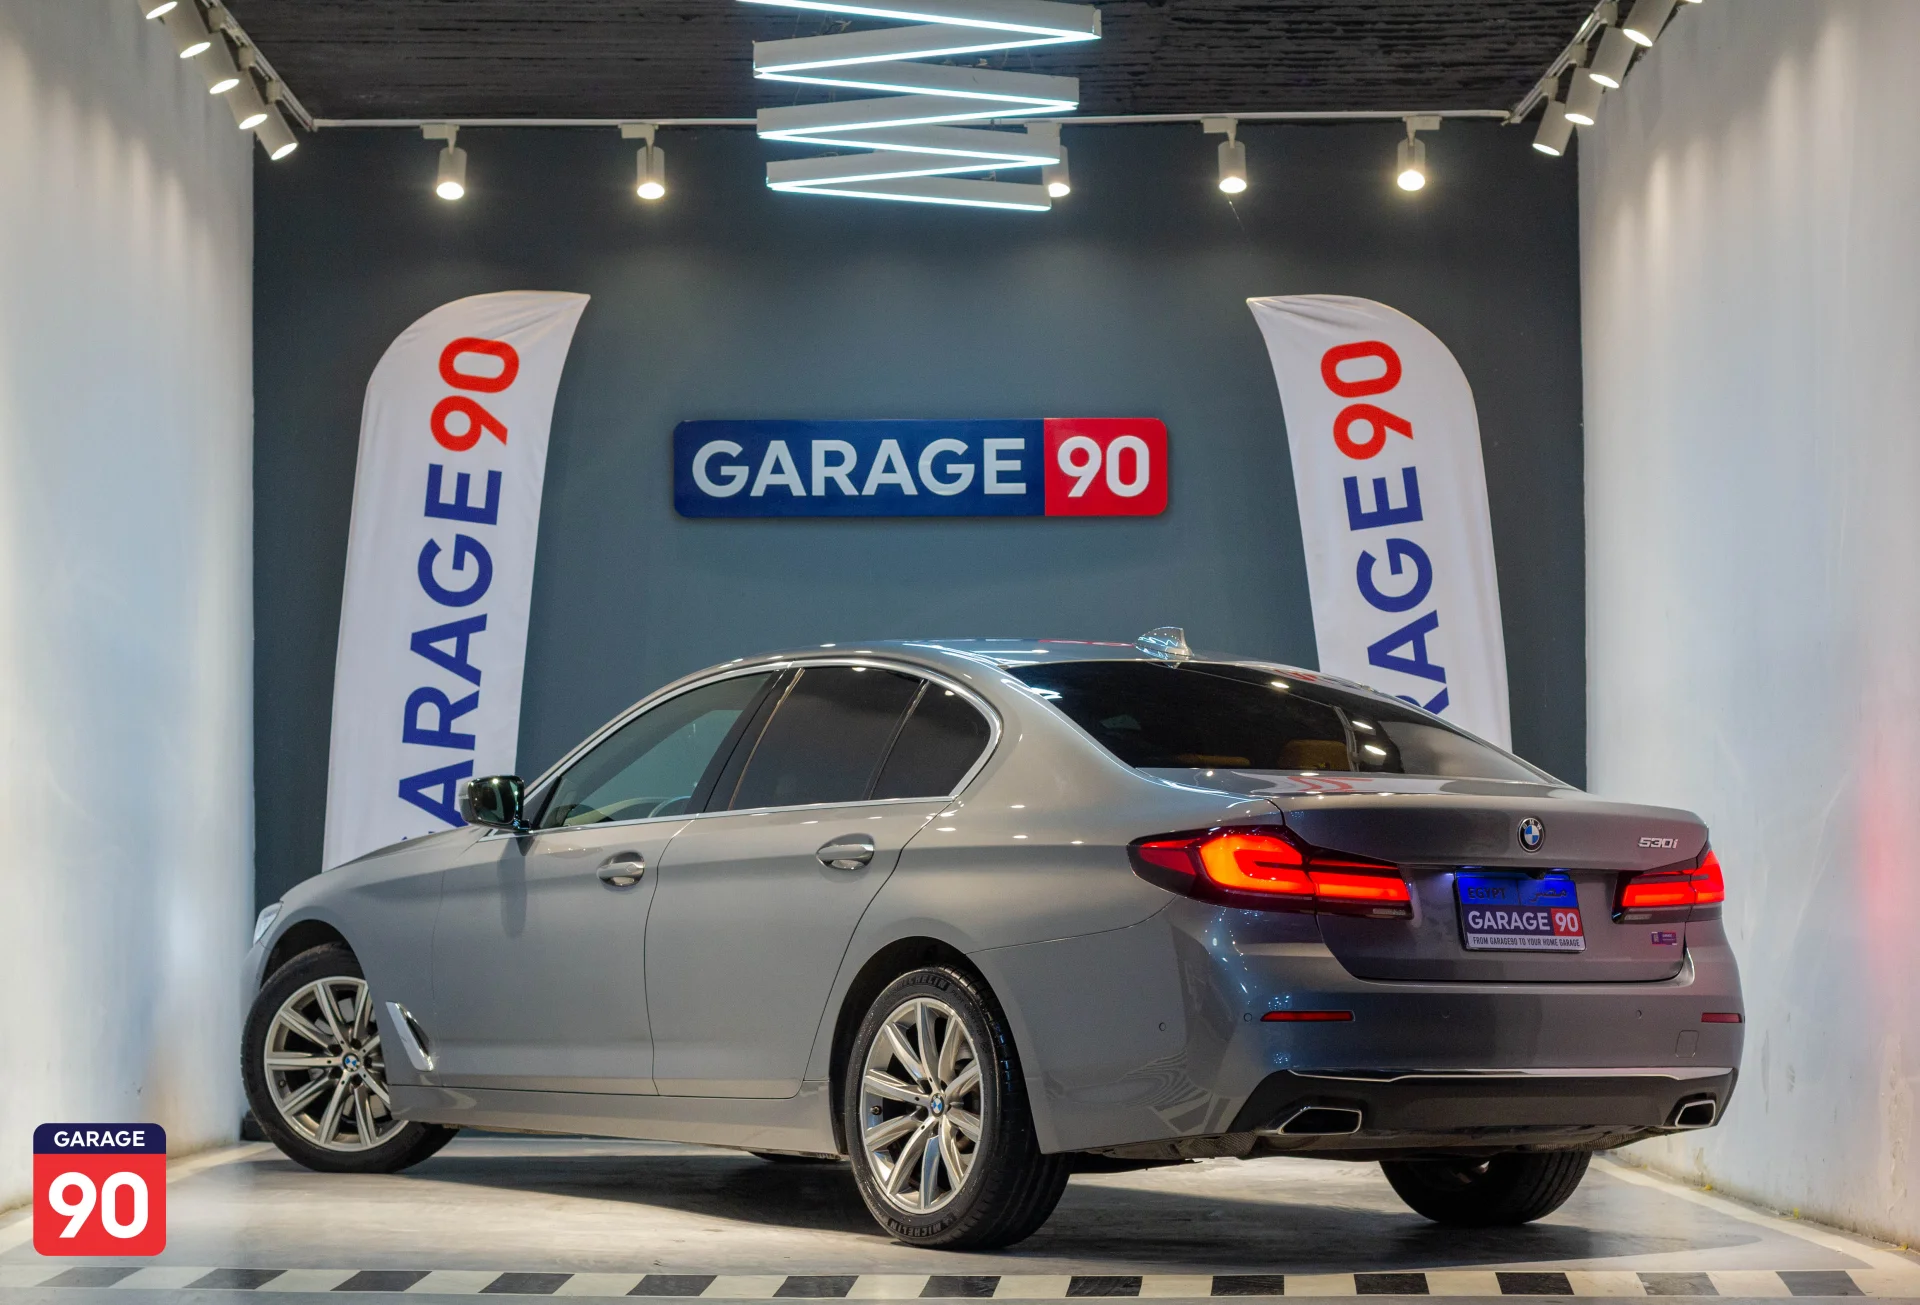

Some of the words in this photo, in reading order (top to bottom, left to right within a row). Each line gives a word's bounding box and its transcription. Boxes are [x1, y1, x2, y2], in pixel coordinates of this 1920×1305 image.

[692, 438, 1027, 498] GARAGE
[1057, 435, 1150, 498] 90
[1638, 837, 1678, 849] 530i
[1468, 887, 1506, 900] EGYPT
[1468, 910, 1551, 931] GARAGE
[1555, 912, 1579, 932] 90
[1473, 936, 1489, 945] FROM
[1490, 937, 1518, 946] GARAGE90
[1519, 938, 1527, 946] TO
[1527, 938, 1542, 946] YOUR
[1542, 938, 1558, 946] HOME
[1560, 939, 1580, 947] GARAGE
